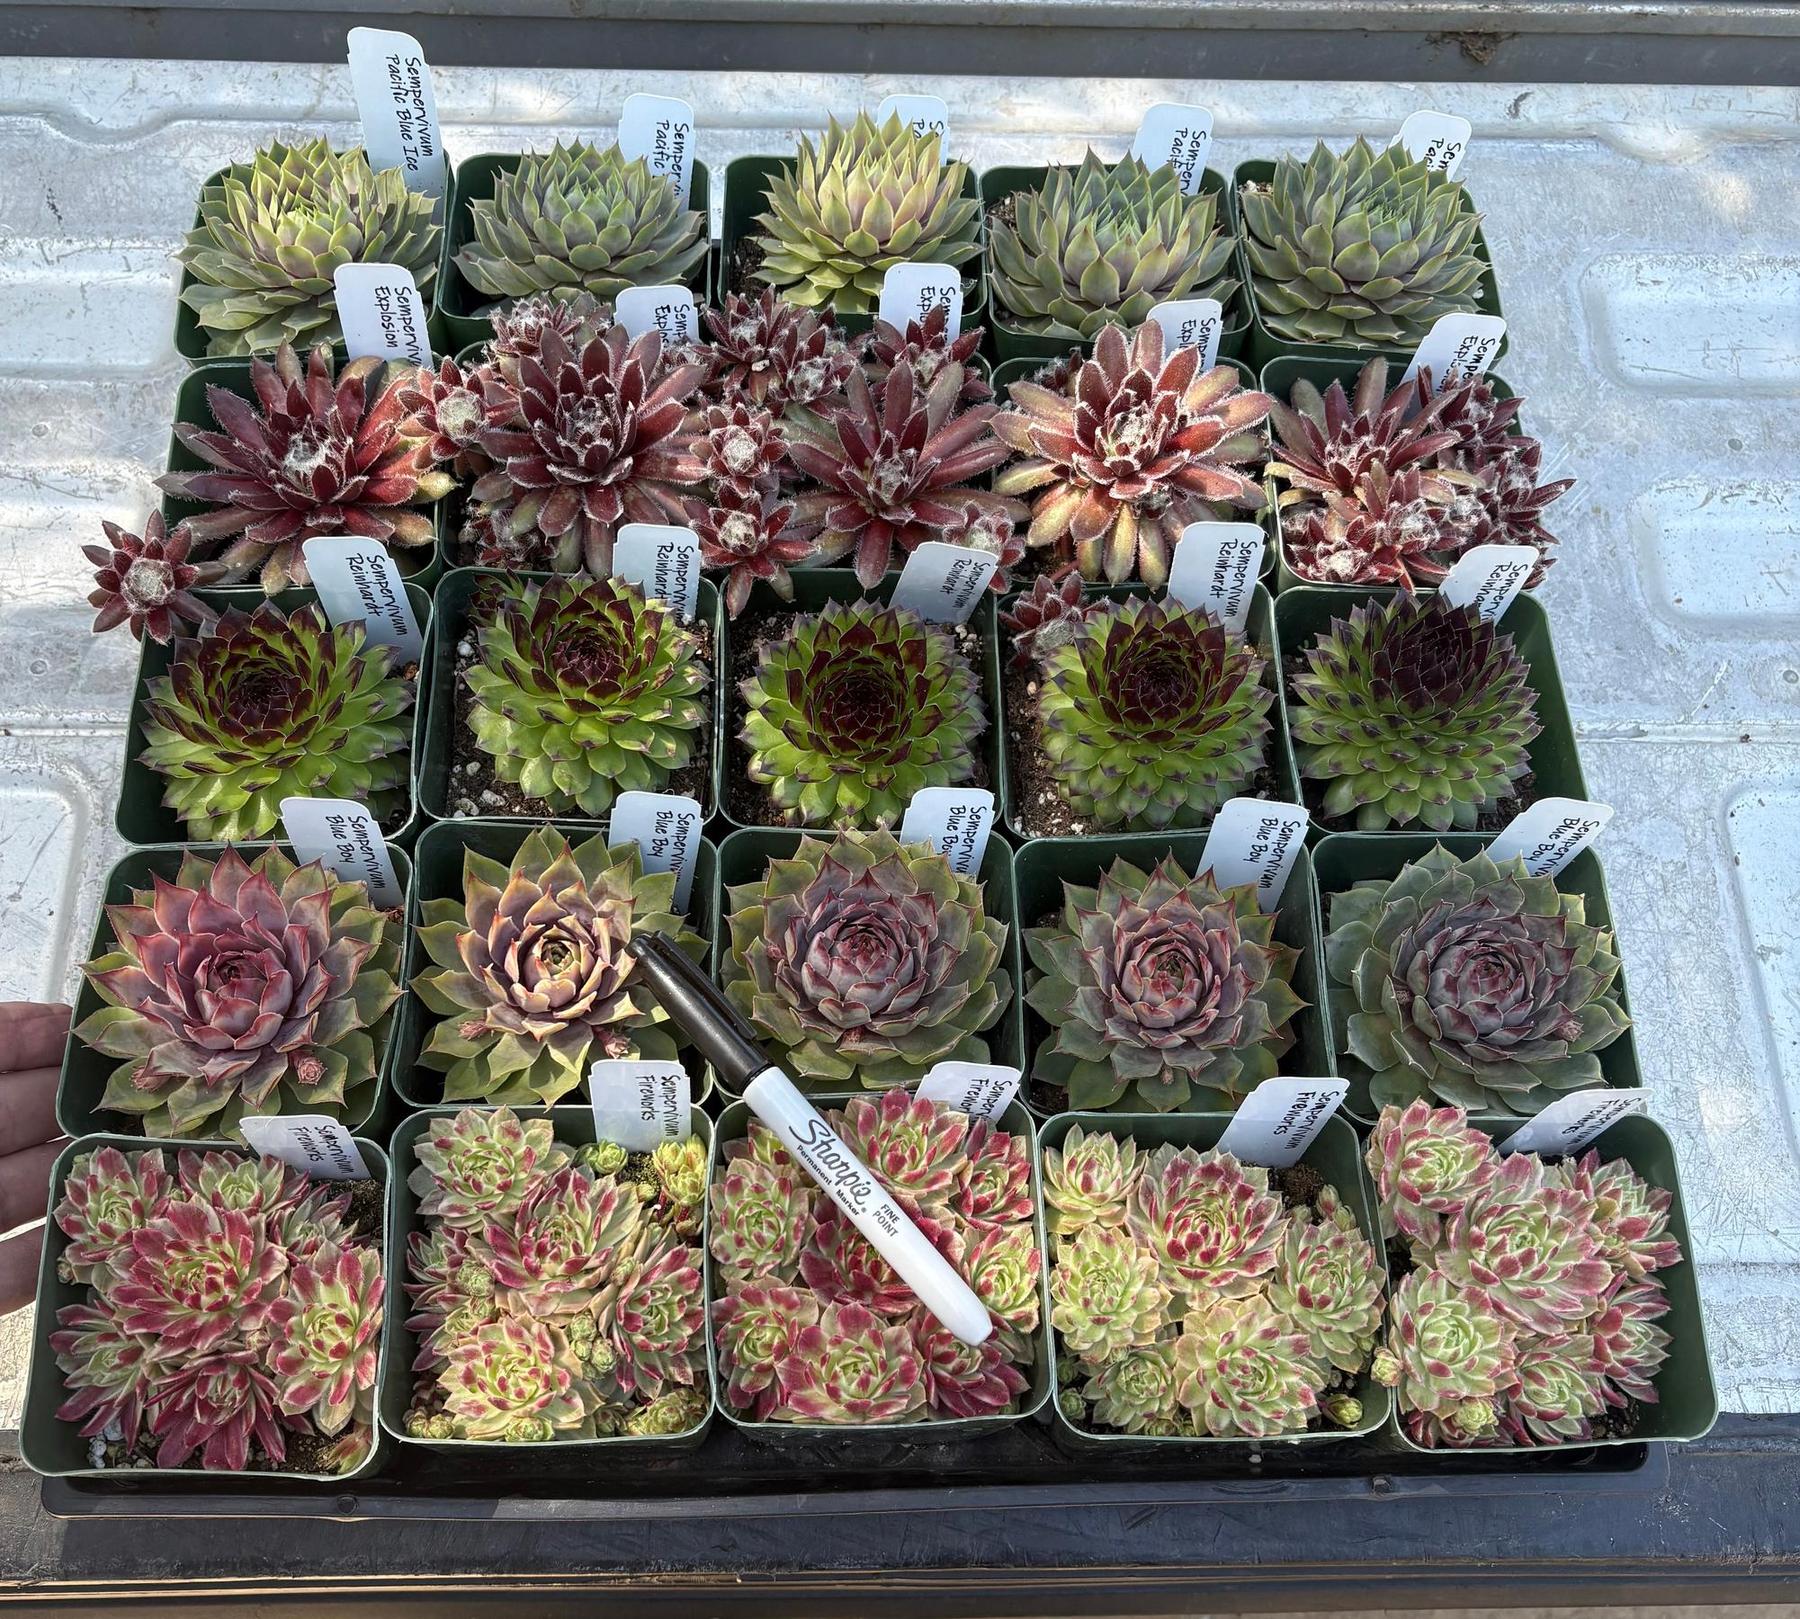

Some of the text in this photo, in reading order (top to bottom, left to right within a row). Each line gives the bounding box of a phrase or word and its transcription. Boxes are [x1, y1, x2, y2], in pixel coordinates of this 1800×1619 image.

[386, 54, 419, 171] Pacific Blue Ice
[405, 57, 433, 156] Sempervivum
[653, 120, 670, 169] Pacific
[374, 286, 400, 348] Explosion
[346, 553, 383, 616] Reinhardt
[367, 555, 408, 635] Sempervivum
[1210, 538, 1238, 598] Reinhardt
[1224, 541, 1258, 617] Sempervivum
[326, 815, 355, 863] Blue Boy
[647, 811, 673, 857] Blue Boy
[947, 805, 966, 831] Blue
[1243, 818, 1278, 863] Blue Boy
[1523, 818, 1580, 861] Blue Boy
[348, 816, 386, 888] Sempervivum
[1258, 821, 1300, 888] Sempervivum
[635, 1075, 660, 1120] Fireworks
[658, 1075, 682, 1136] Sempervivum
[1273, 1091, 1316, 1135] Fireworks
[789, 1119, 871, 1205] Sharpie
[797, 1145, 860, 1216] Permanent Marker
[872, 1210, 898, 1237] POINT
[881, 1204, 900, 1224] FINE
